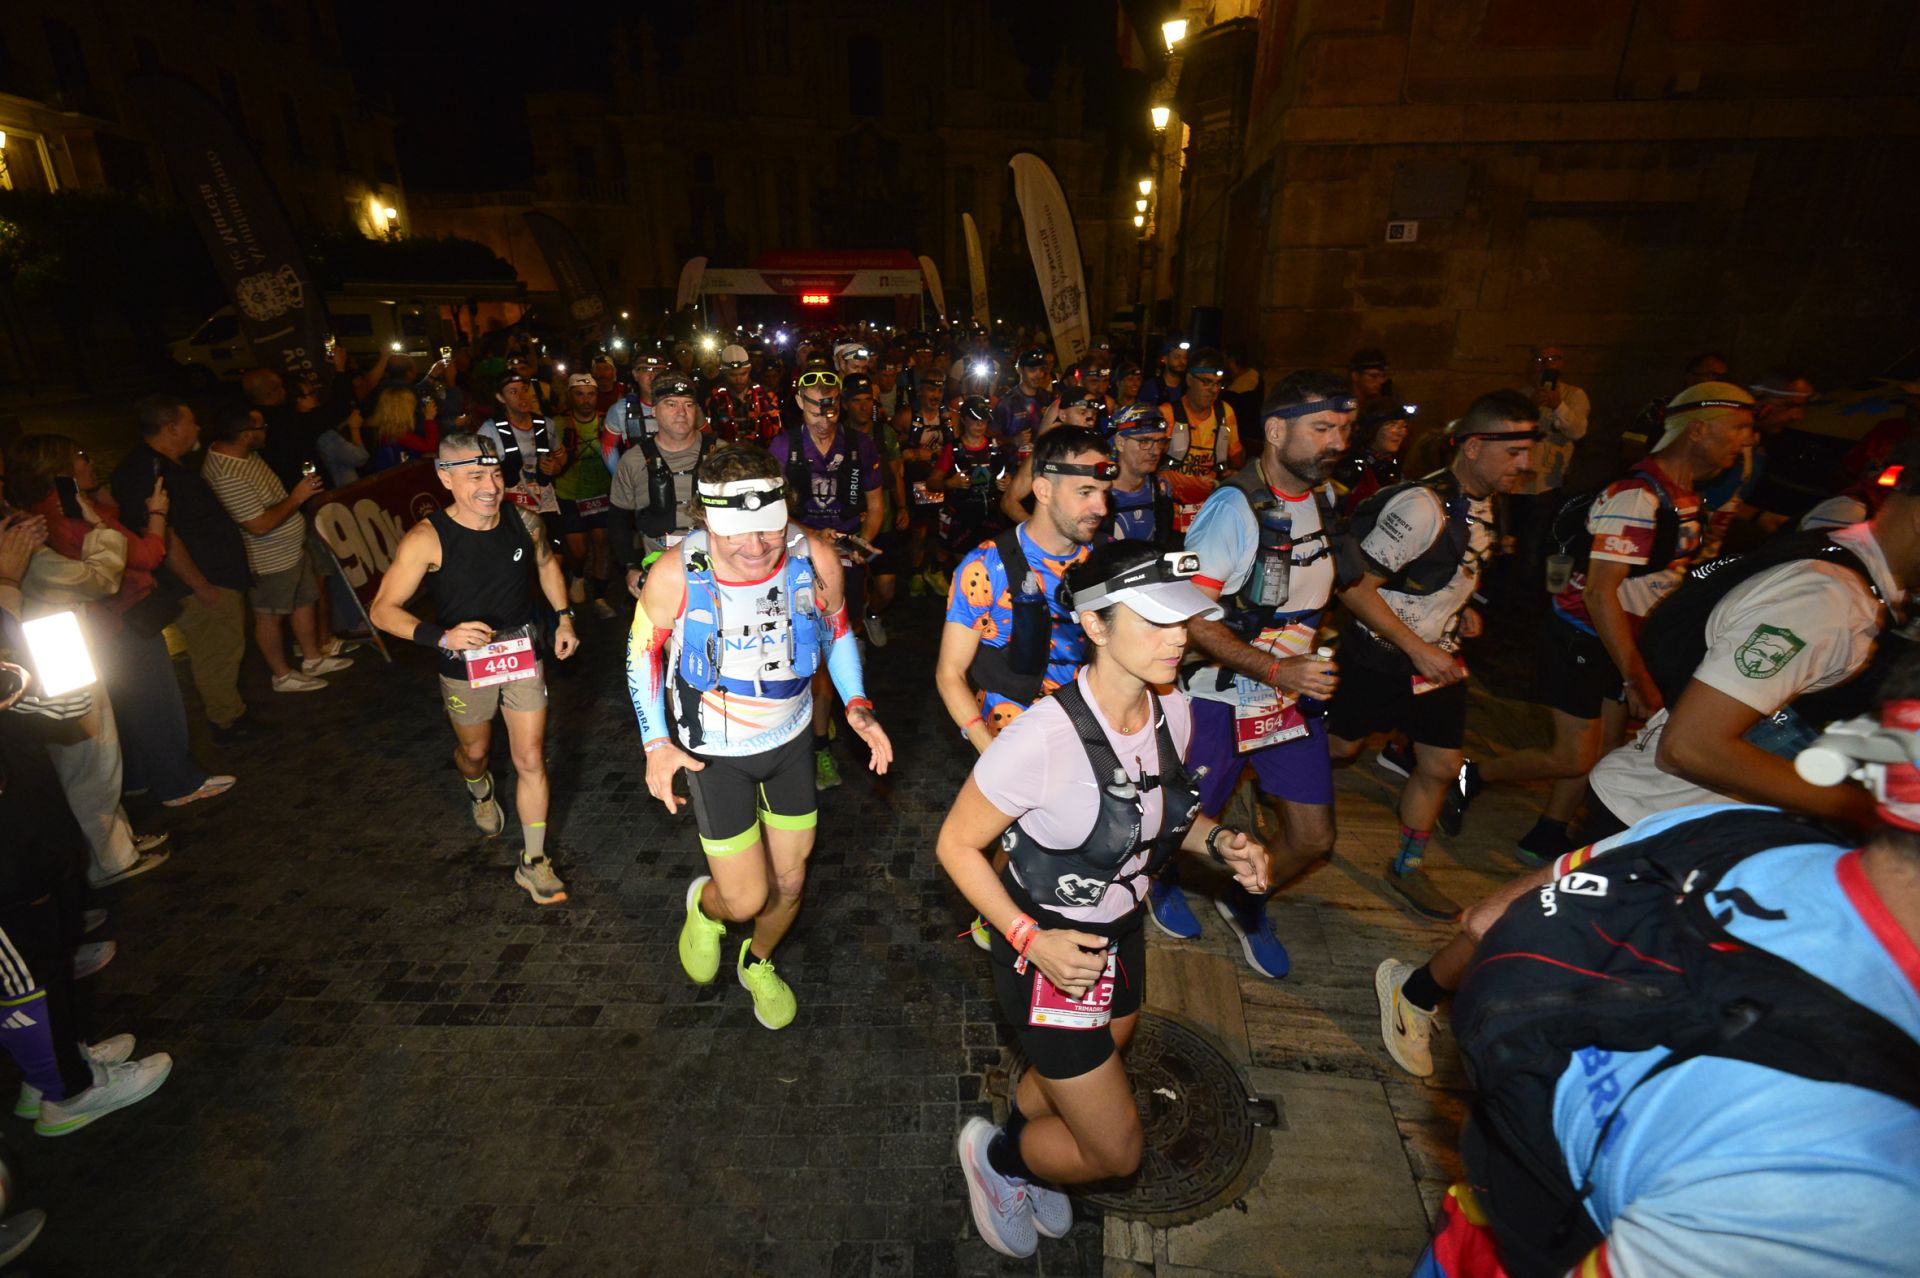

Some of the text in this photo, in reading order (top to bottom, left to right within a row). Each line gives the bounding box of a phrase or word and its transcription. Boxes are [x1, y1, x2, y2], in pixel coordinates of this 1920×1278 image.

[848, 468, 860, 505] KIPRUN
[485, 656, 519, 673] 440
[633, 700, 651, 733] FIBRA
[1254, 713, 1283, 735] 364
[1065, 983, 1115, 1006] 13
